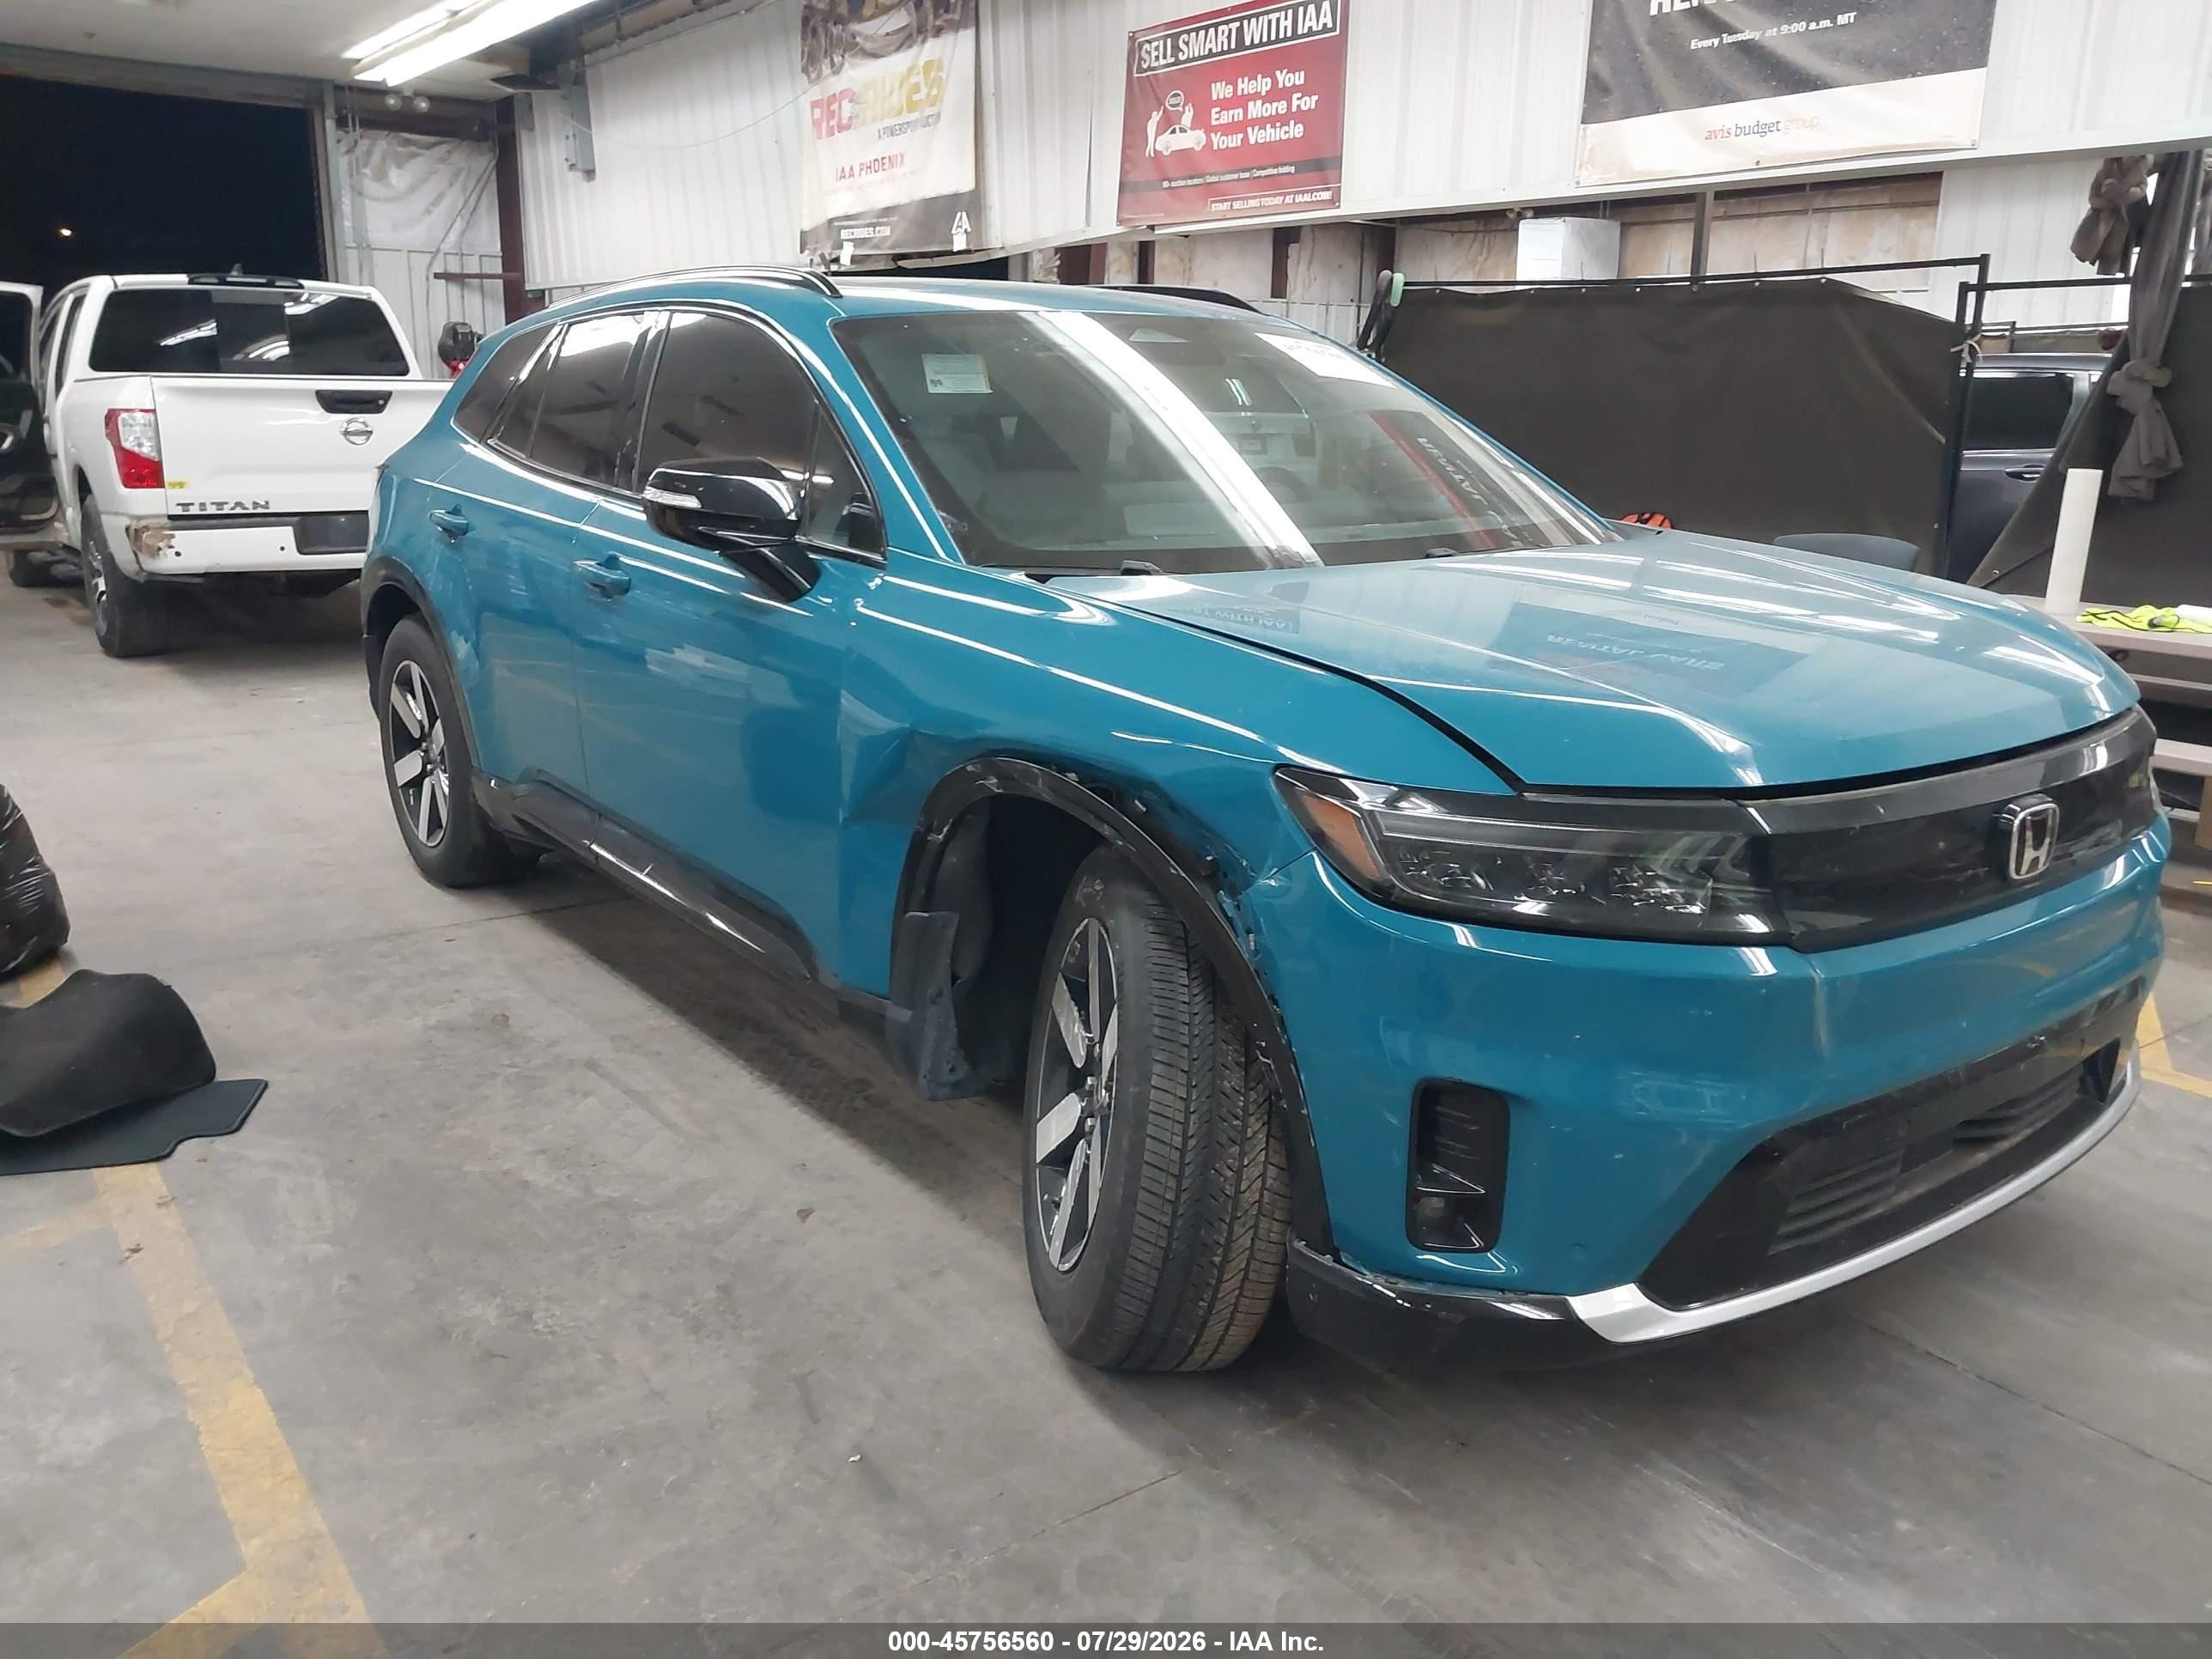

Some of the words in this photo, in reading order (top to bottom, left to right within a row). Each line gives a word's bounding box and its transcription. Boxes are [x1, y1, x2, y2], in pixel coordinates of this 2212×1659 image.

[1140, 37, 1176, 69] SELL
[1178, 20, 1241, 60] SMART
[1243, 8, 1293, 46] WITH
[1297, 1, 1334, 35] IAA
[1690, 37, 1720, 50] Every
[1721, 28, 1762, 44] Tuesday
[1765, 27, 1778, 38] at
[1779, 21, 1807, 35] 9:00
[1808, 17, 1833, 31] a.m.
[1836, 11, 1857, 26] MT
[1210, 81, 1233, 100] We
[1237, 73, 1272, 96] Help
[1274, 68, 1305, 88] You
[1210, 107, 1243, 125] Earn
[1247, 99, 1288, 120] More
[1291, 92, 1319, 112] For
[1210, 131, 1243, 150] Your
[1247, 119, 1304, 145] Vehicle
[1705, 124, 1732, 141] avis
[1735, 119, 1783, 138] budget
[836, 164, 855, 182] IAA
[859, 151, 907, 178] PHOENIX
[1211, 201, 1231, 211] START
[1232, 198, 1260, 210] SELLING
[1260, 196, 1285, 207] TODAY
[1285, 194, 1294, 204] AT
[175, 500, 270, 513] TITAN
